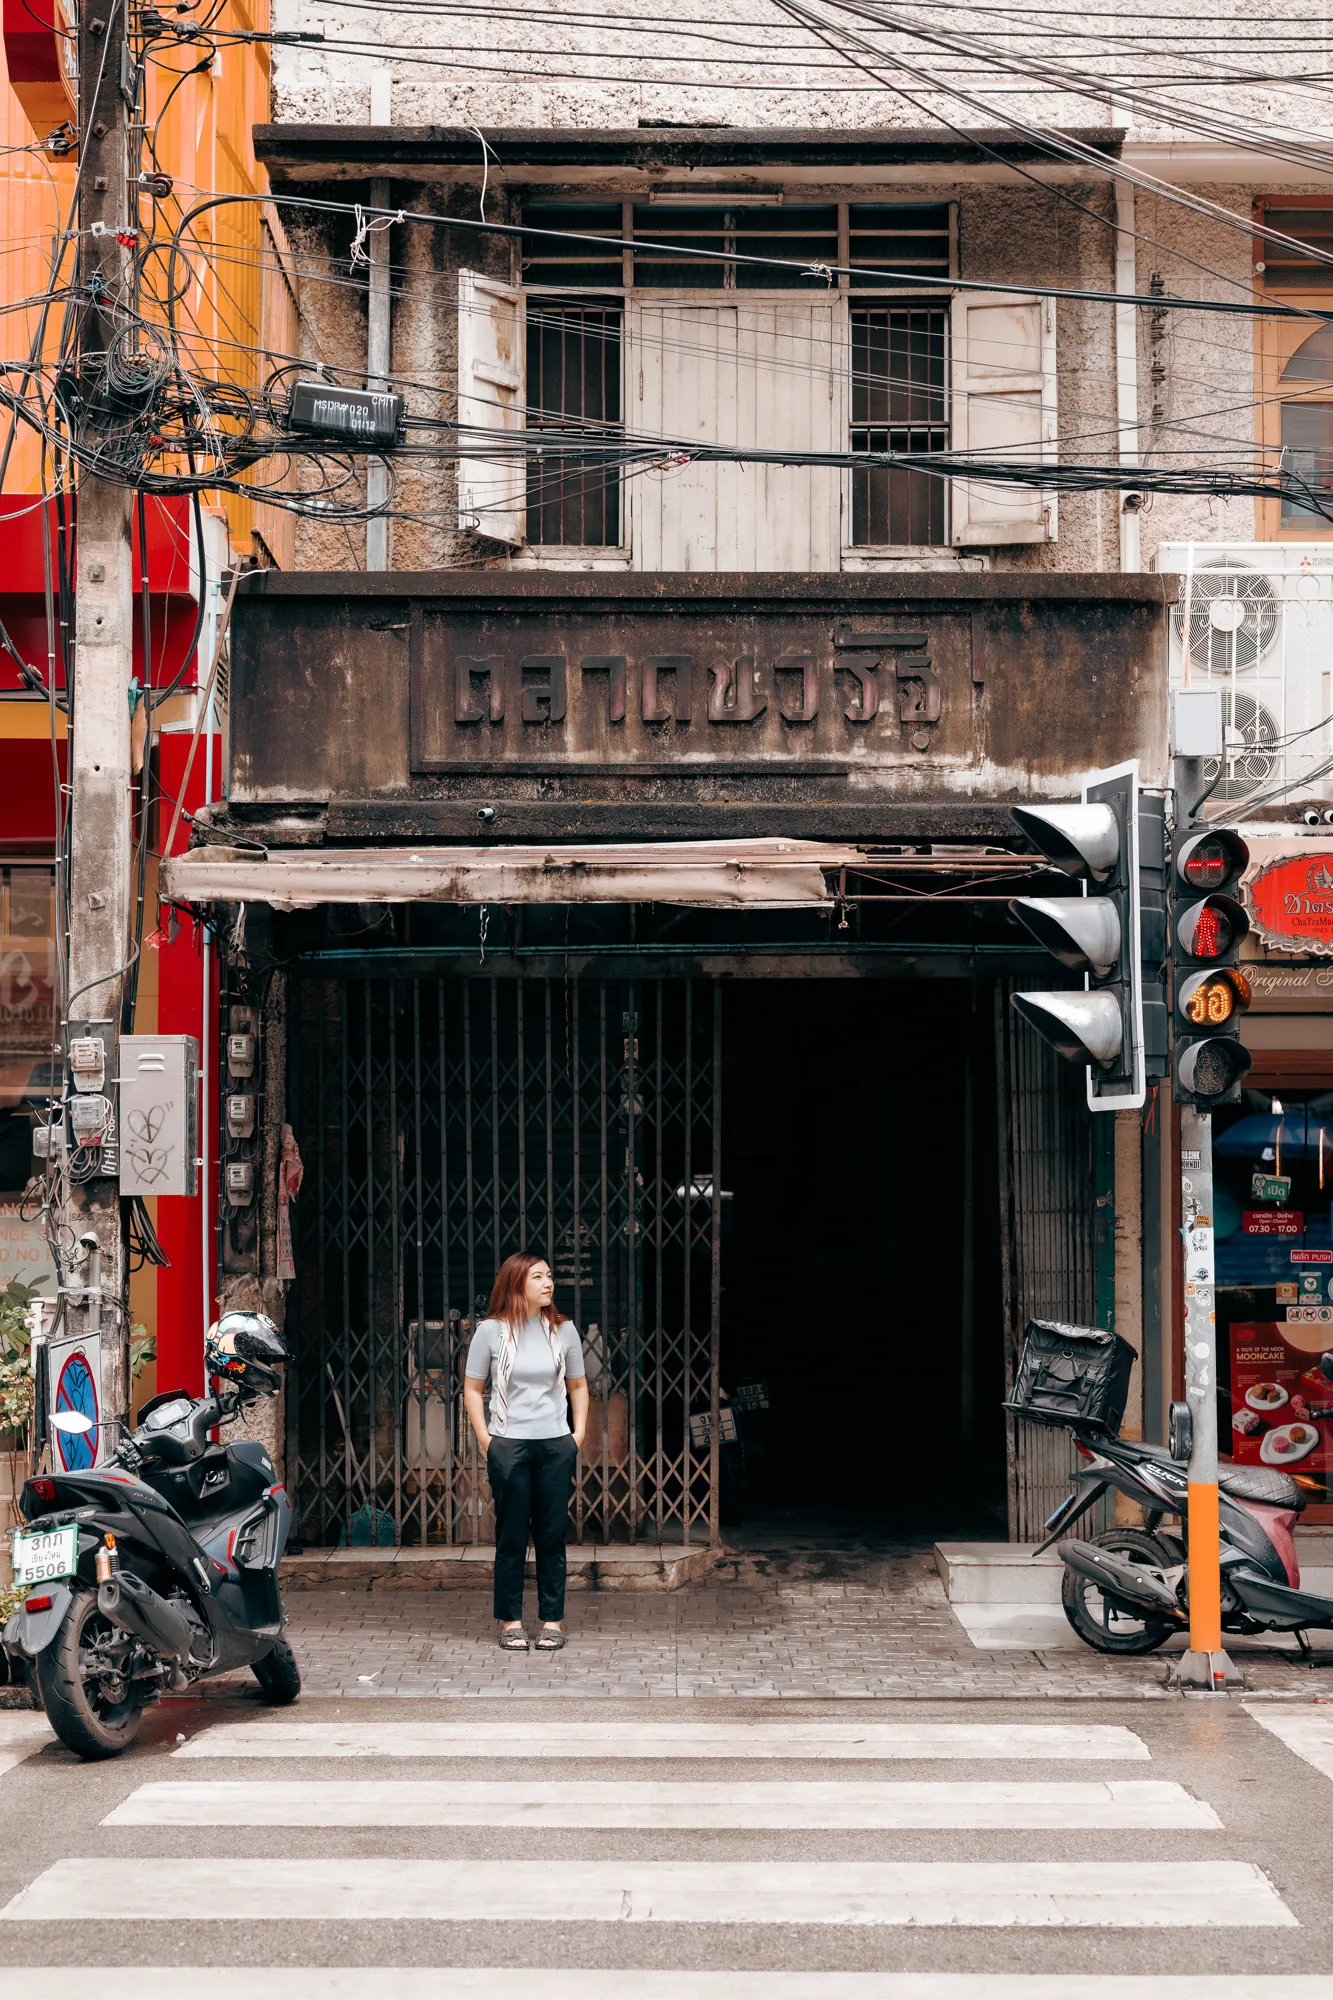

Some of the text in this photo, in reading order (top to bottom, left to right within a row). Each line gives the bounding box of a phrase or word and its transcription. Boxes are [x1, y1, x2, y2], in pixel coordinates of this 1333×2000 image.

[351, 419, 376, 431] 01:12
[1292, 917, 1333, 926] ChaTraMu
[1239, 965, 1313, 996] Original
[1267, 1186, 1285, 1196] เปิด
[1248, 1225, 1270, 1233] 07.30
[1277, 1225, 1298, 1233] 17.00
[1311, 1253, 1331, 1261] PUSH
[1236, 1352, 1285, 1360] MOONCAKE
[1146, 1464, 1187, 1487] CLICK
[31, 1549, 62, 1564] เชียงใหม่
[25, 1561, 67, 1581] 5506
